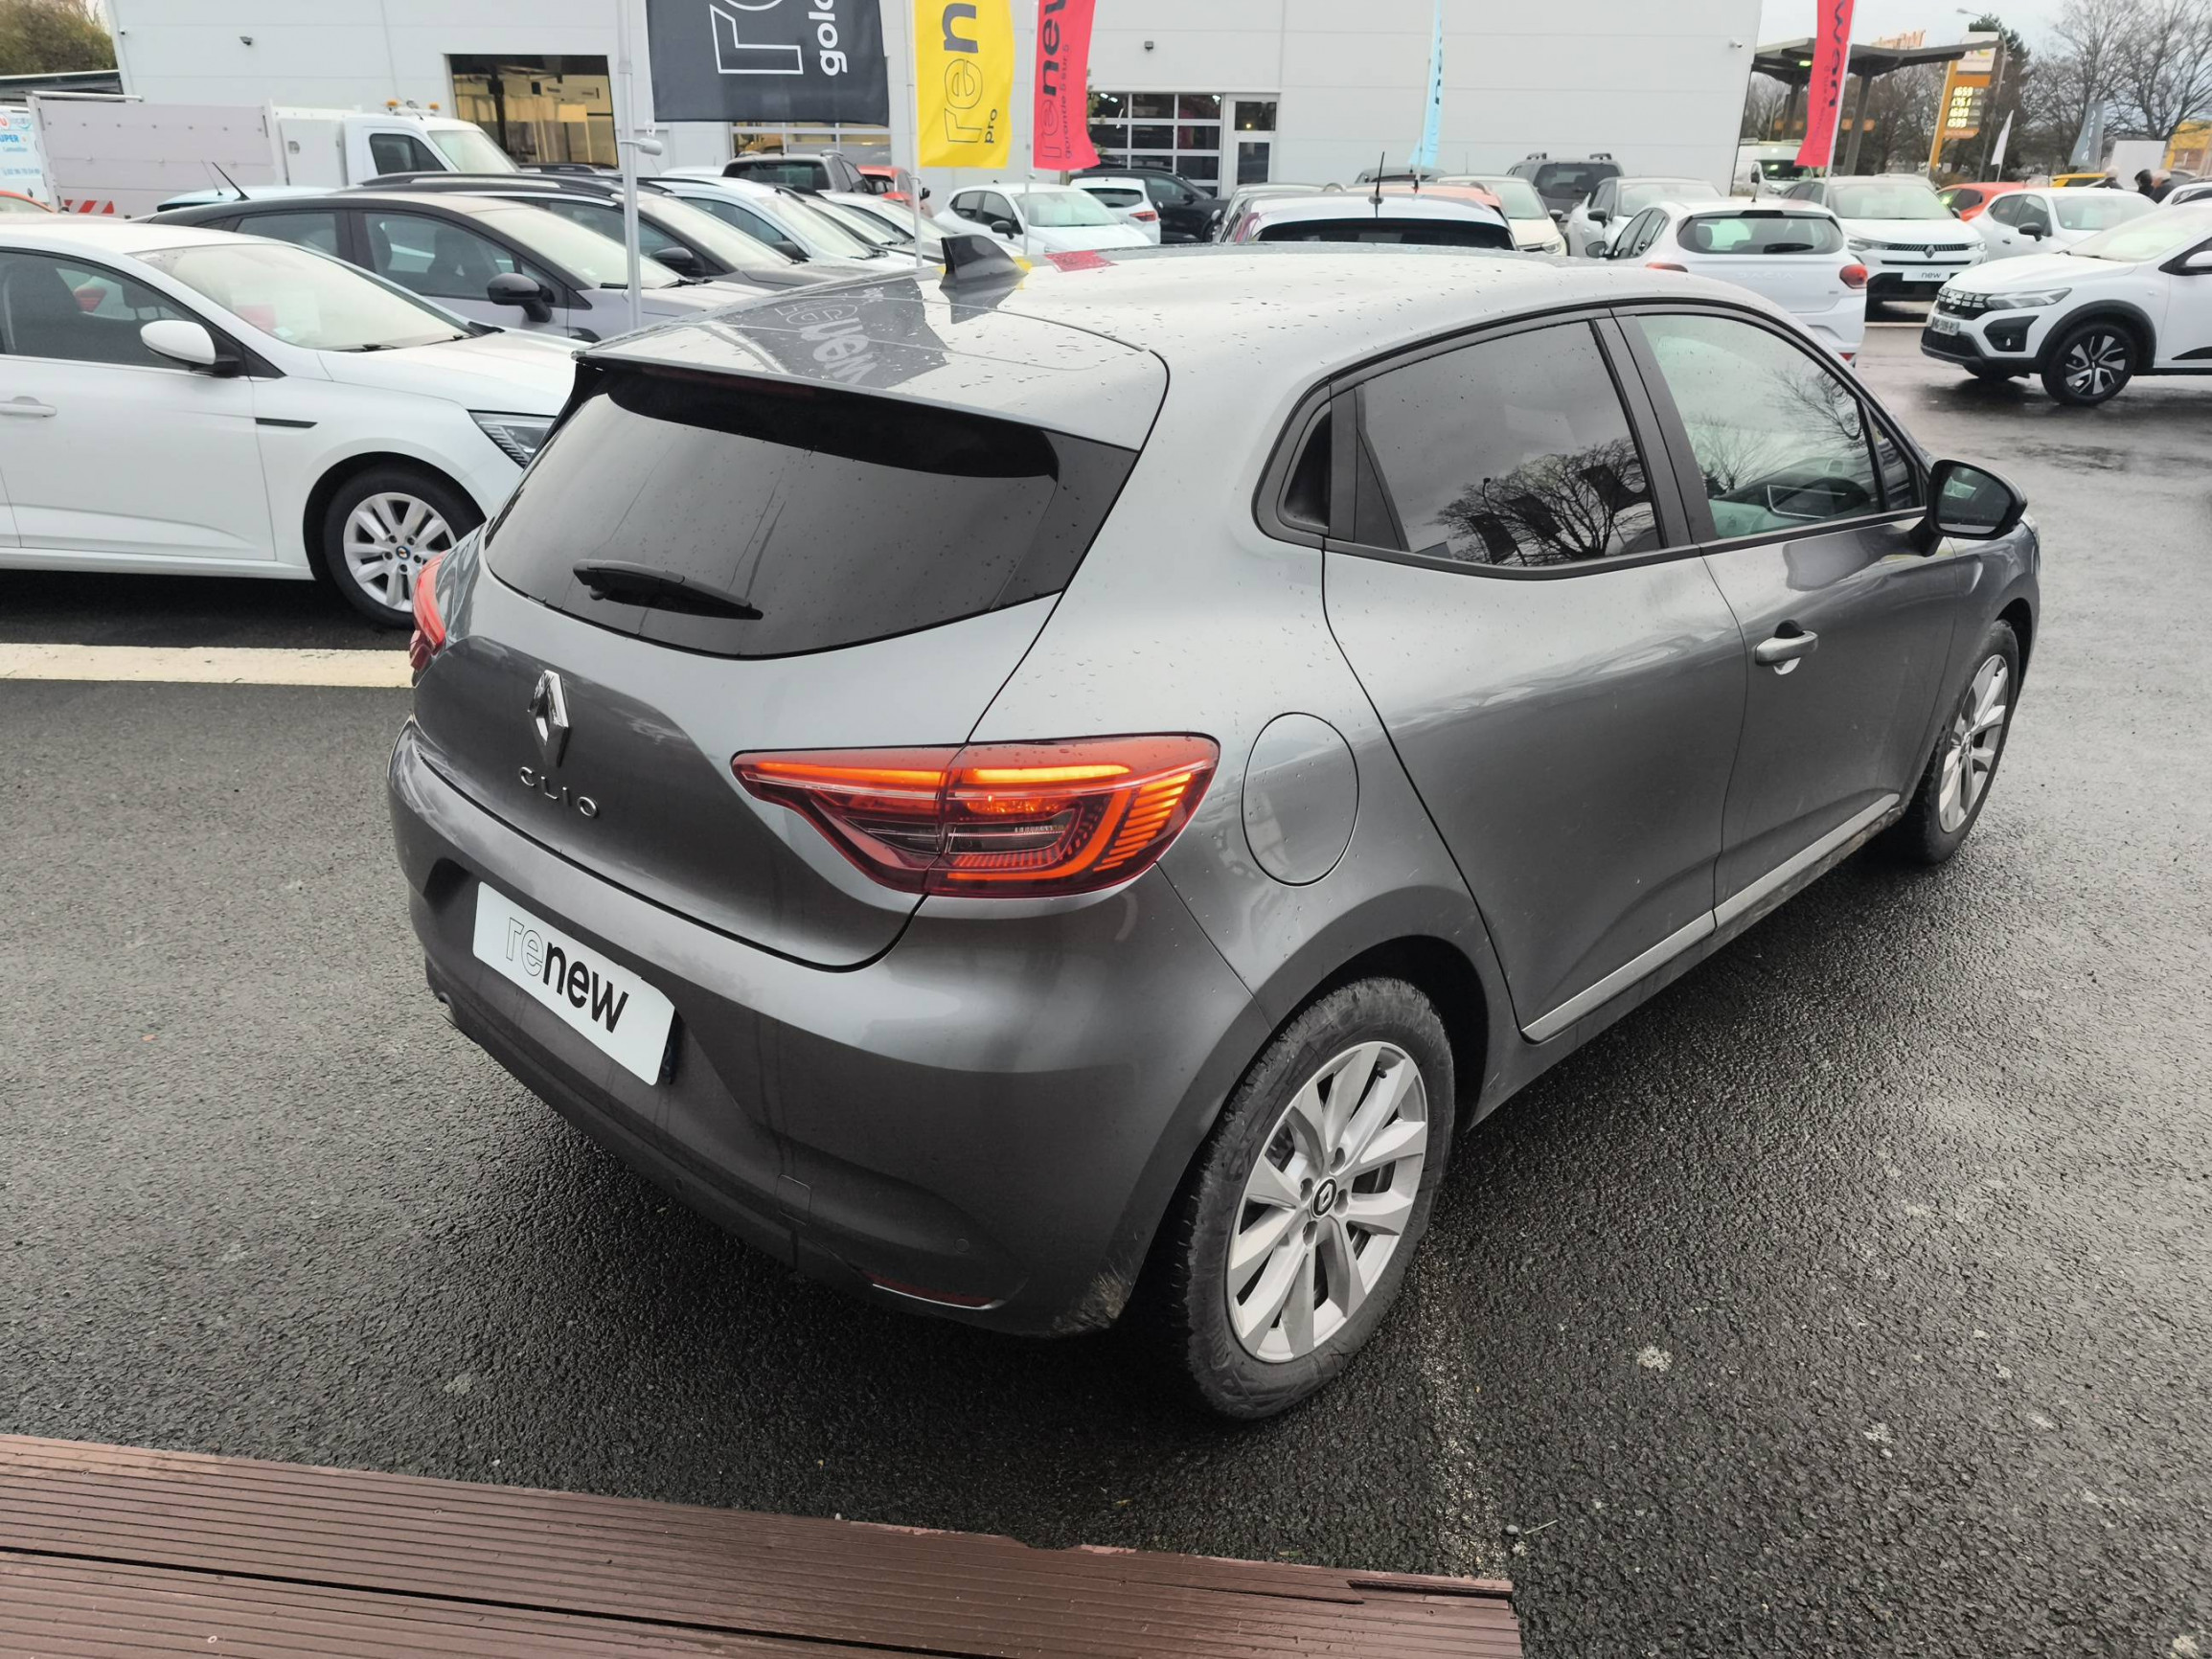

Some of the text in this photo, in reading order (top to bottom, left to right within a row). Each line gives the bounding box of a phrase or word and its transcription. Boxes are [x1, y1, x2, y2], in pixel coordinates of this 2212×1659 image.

[984, 108, 998, 144] pro
[518, 765, 600, 818] CLIO
[505, 916, 629, 1034] renew
